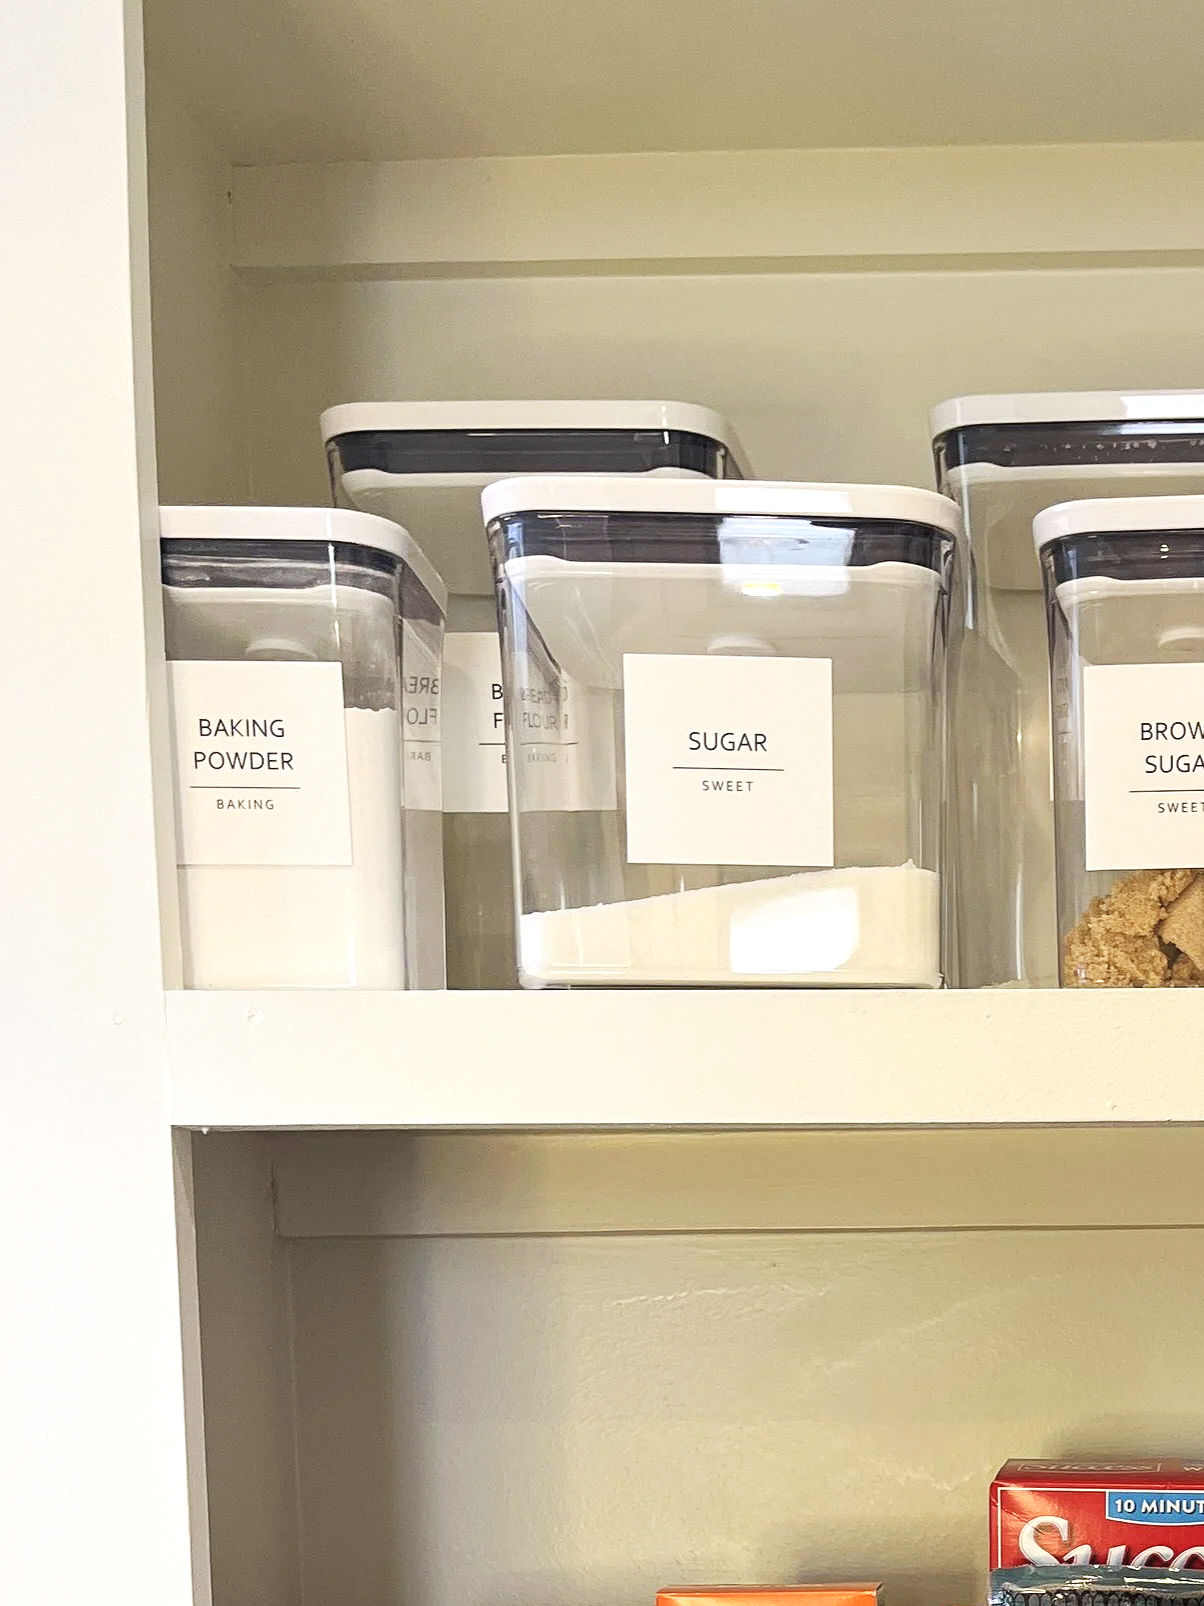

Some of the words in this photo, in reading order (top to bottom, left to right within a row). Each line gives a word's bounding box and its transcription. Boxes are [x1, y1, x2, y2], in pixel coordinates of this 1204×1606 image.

[198, 718, 285, 739] BAKING
[688, 731, 768, 753] SUGAR
[193, 751, 294, 772] POWDER
[701, 779, 753, 792] SWEET
[215, 799, 276, 811] BAKING
[1115, 1499, 1136, 1513] 10
